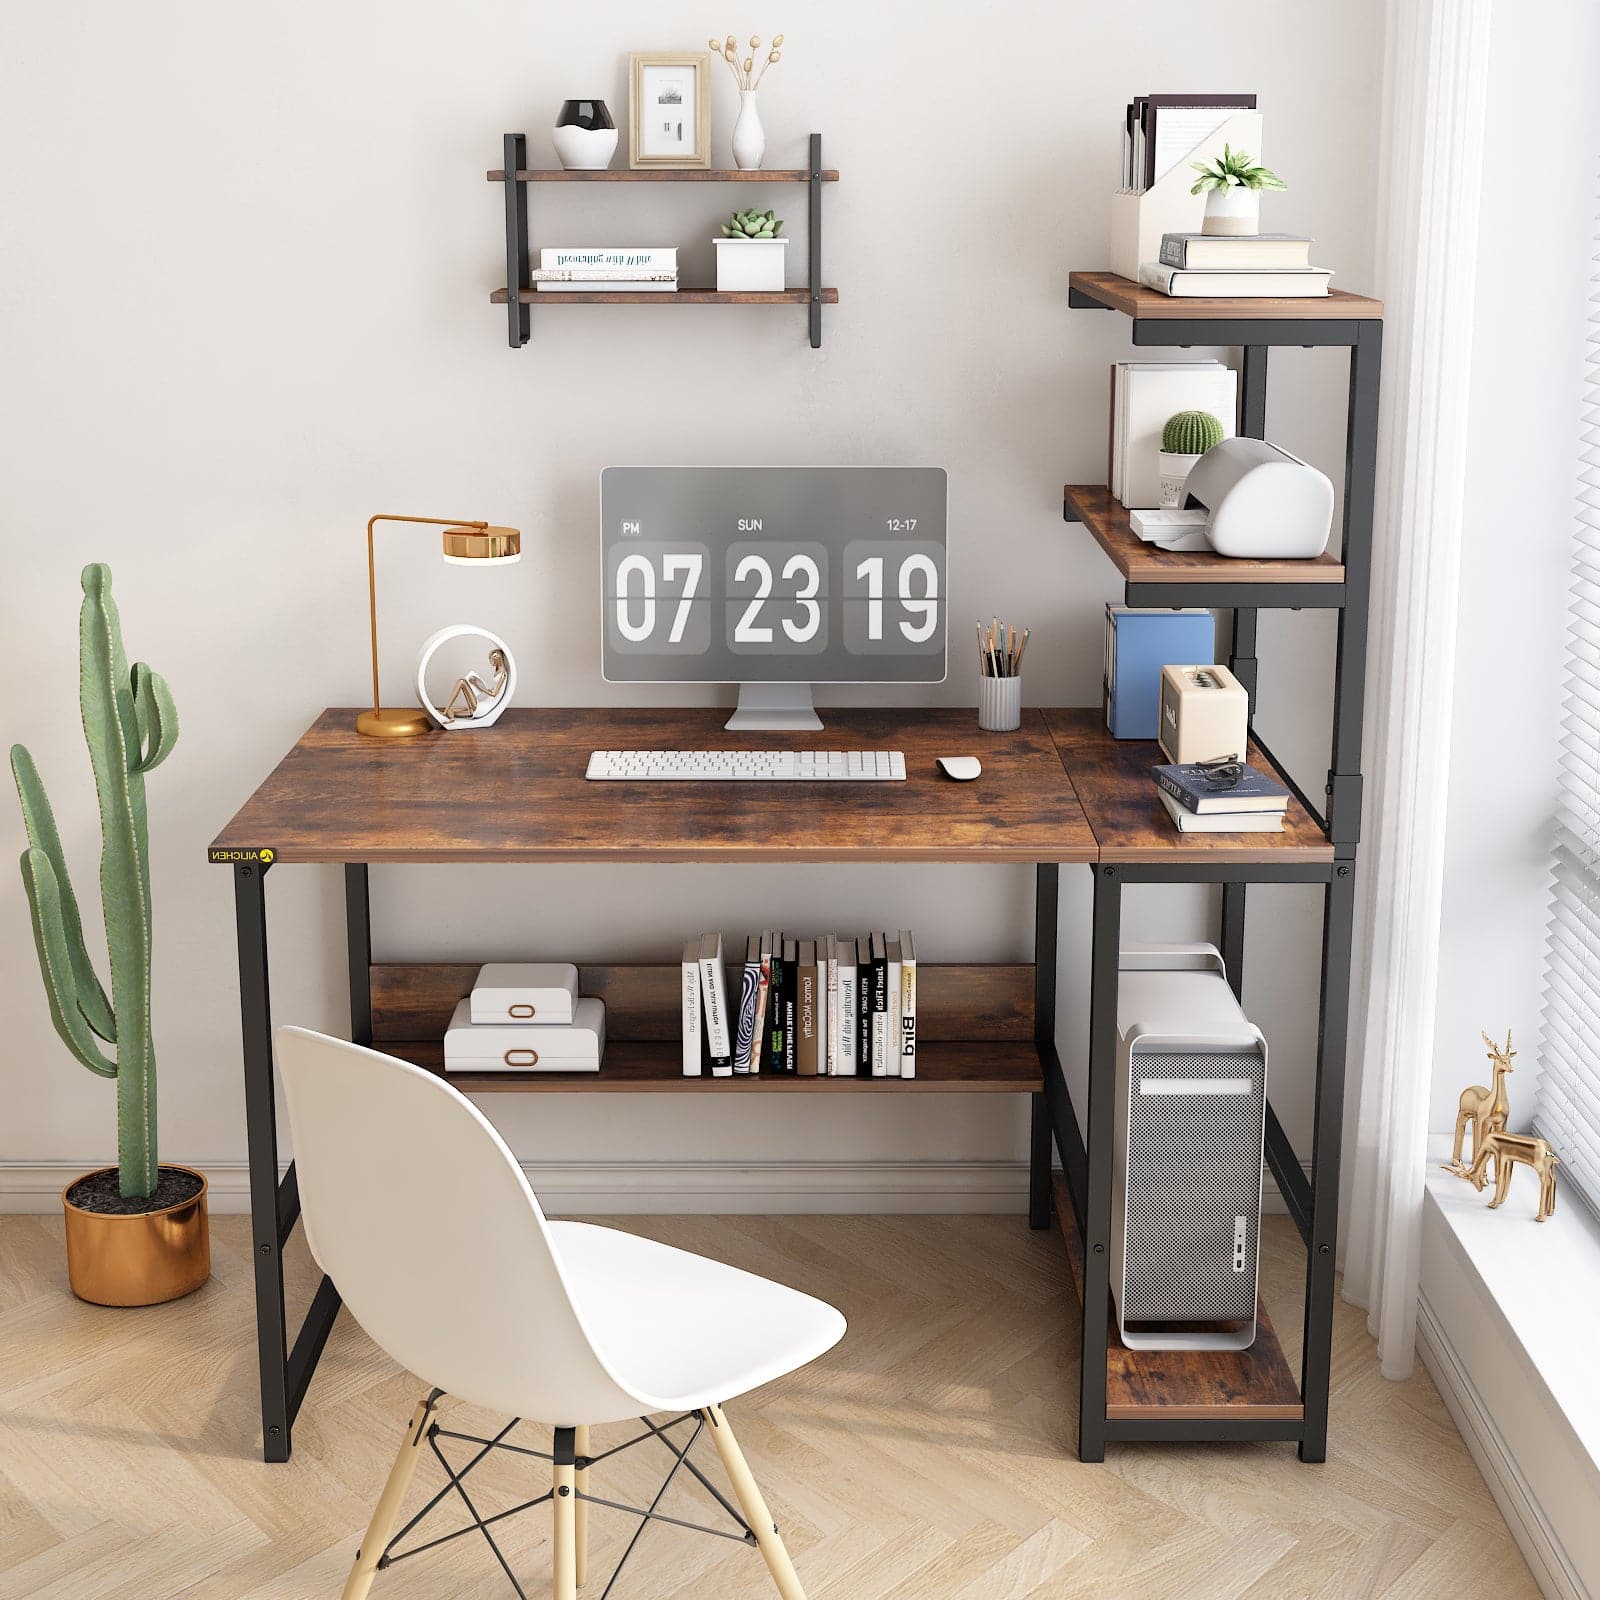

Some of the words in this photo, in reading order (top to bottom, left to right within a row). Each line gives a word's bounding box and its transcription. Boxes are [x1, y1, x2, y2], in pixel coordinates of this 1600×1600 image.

[622, 522, 640, 534] PM
[738, 519, 762, 531] SUN
[886, 520, 917, 531] 12-17
[616, 554, 703, 642] 07
[734, 554, 821, 643] 23
[856, 553, 938, 643] 19
